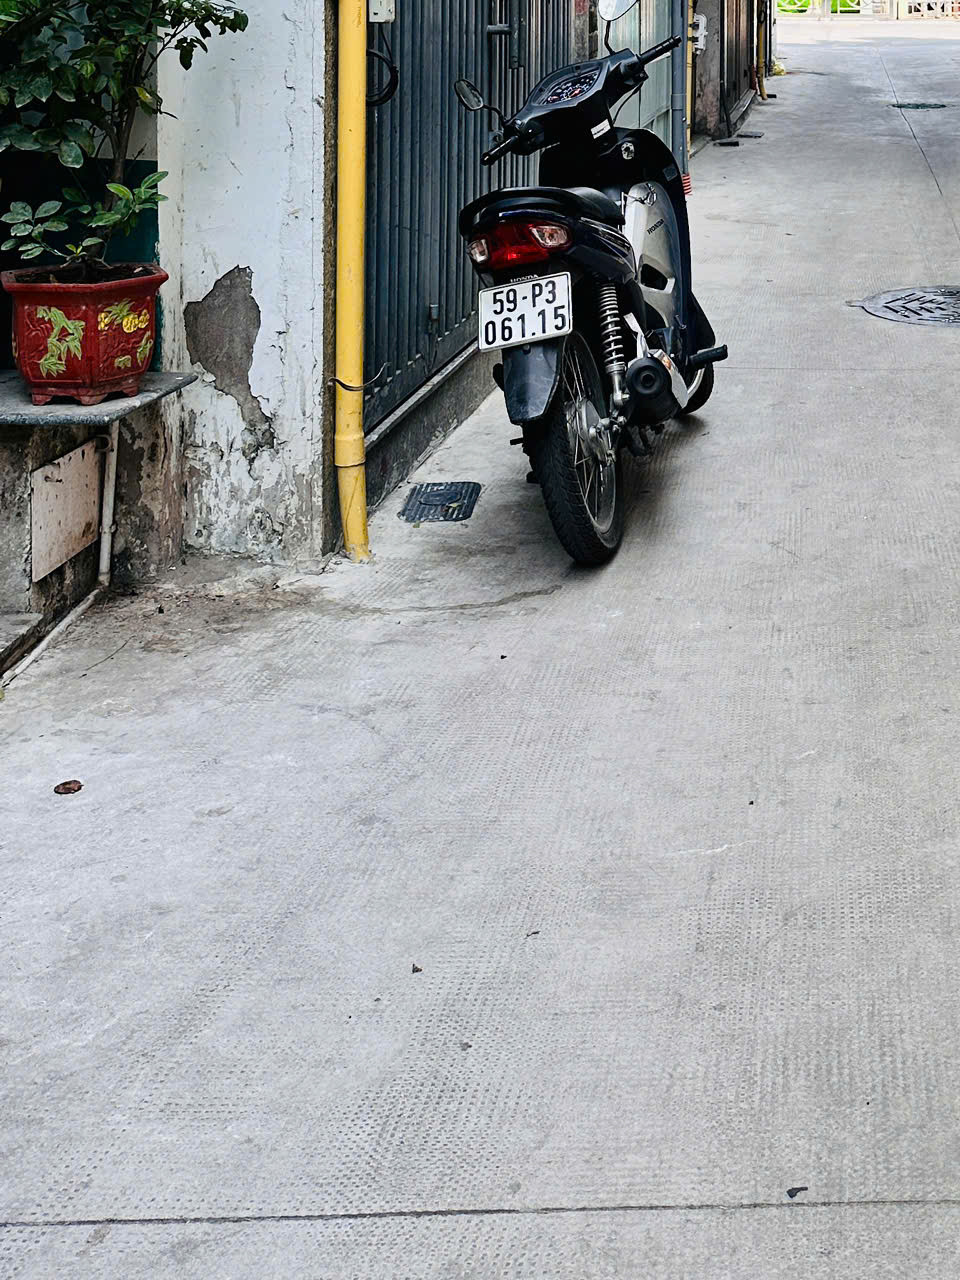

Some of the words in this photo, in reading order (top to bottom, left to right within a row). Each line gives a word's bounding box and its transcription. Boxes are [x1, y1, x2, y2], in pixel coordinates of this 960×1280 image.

[647, 218, 664, 235] HONDA
[493, 280, 557, 315] 59-P3
[485, 305, 567, 345] 061.15
